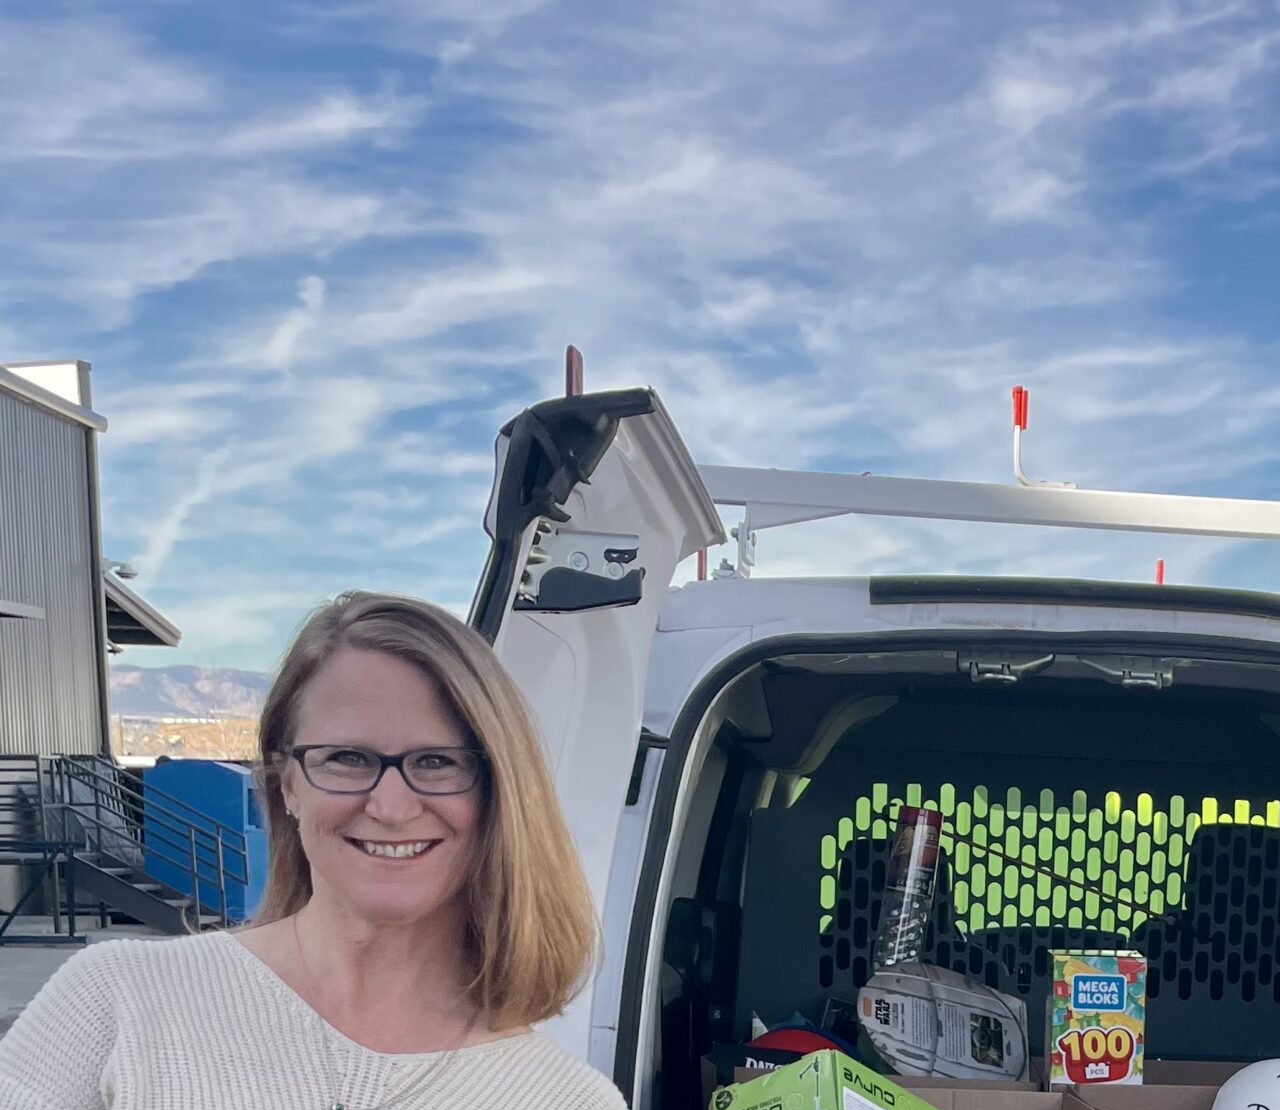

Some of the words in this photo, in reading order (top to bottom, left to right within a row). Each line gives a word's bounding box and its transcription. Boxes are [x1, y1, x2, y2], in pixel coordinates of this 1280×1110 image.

[1078, 981, 1118, 993] MEGA
[1078, 993, 1119, 1005] BLOKS
[882, 1000, 890, 1025] WARS
[1062, 1029, 1131, 1061] 100
